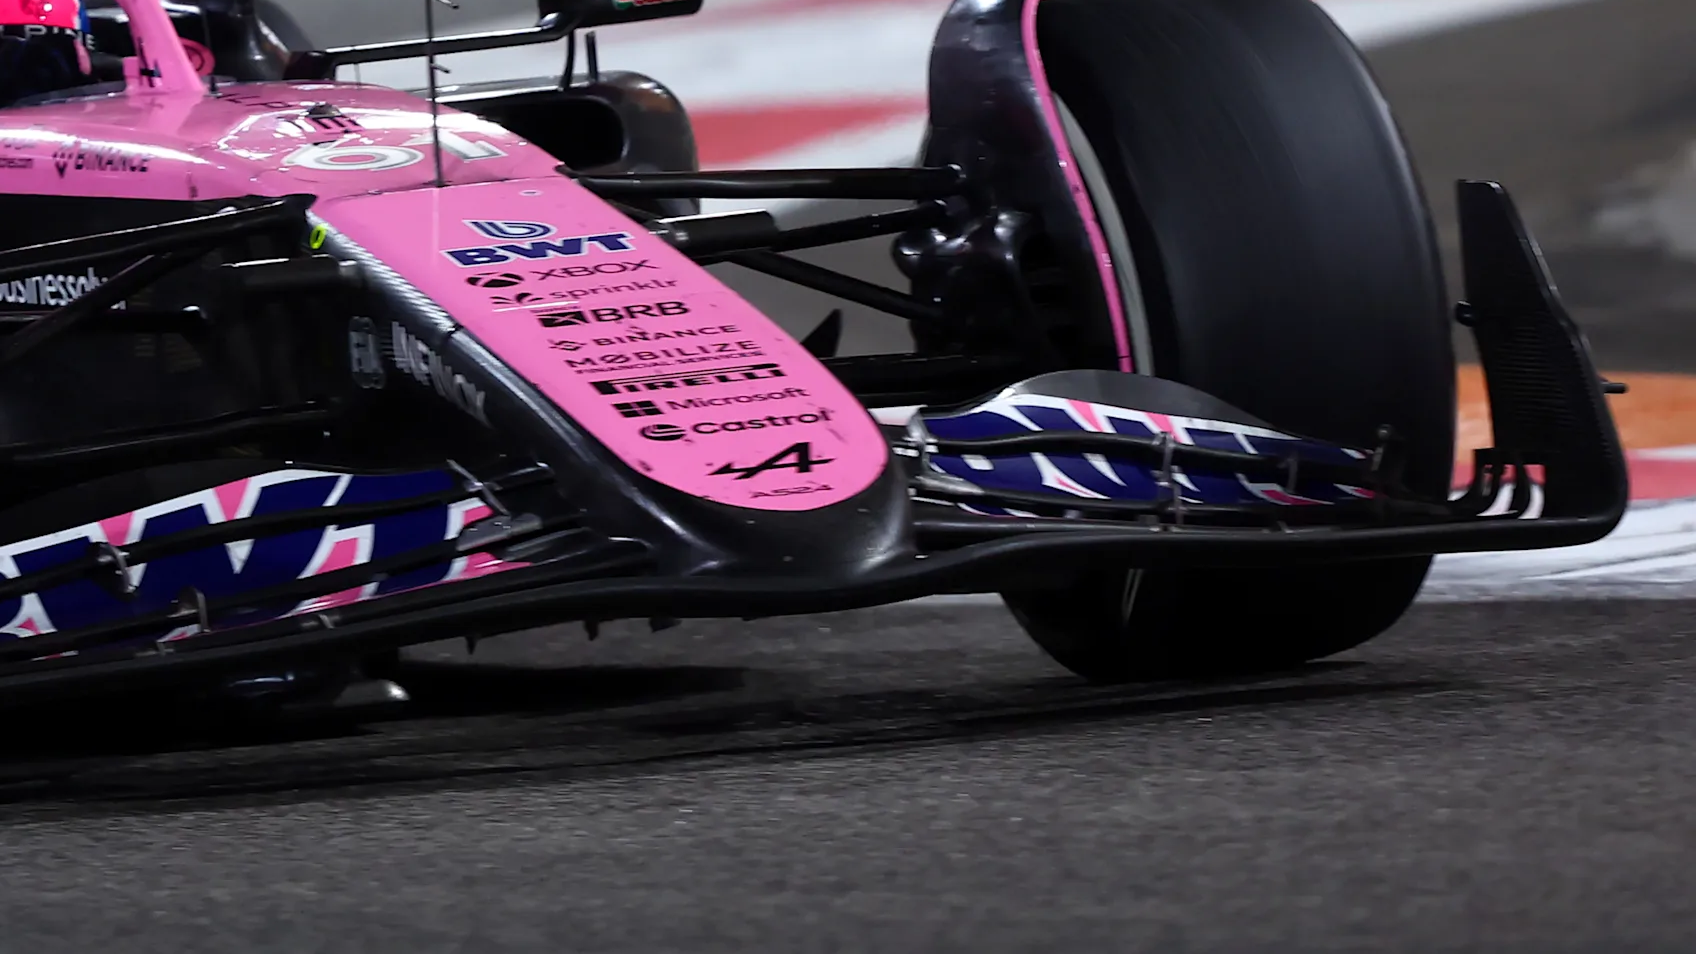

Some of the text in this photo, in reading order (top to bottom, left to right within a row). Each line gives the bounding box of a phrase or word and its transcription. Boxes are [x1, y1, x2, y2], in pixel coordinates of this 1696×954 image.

[442, 231, 635, 267] BWT
[530, 258, 661, 281] XBOX
[548, 279, 679, 300] sprinklr
[590, 300, 692, 323] BRB
[591, 324, 742, 347] BINANCE
[588, 363, 788, 396] PIRELLI
[665, 386, 812, 411] Microsoft
[692, 410, 833, 435] Castrol
